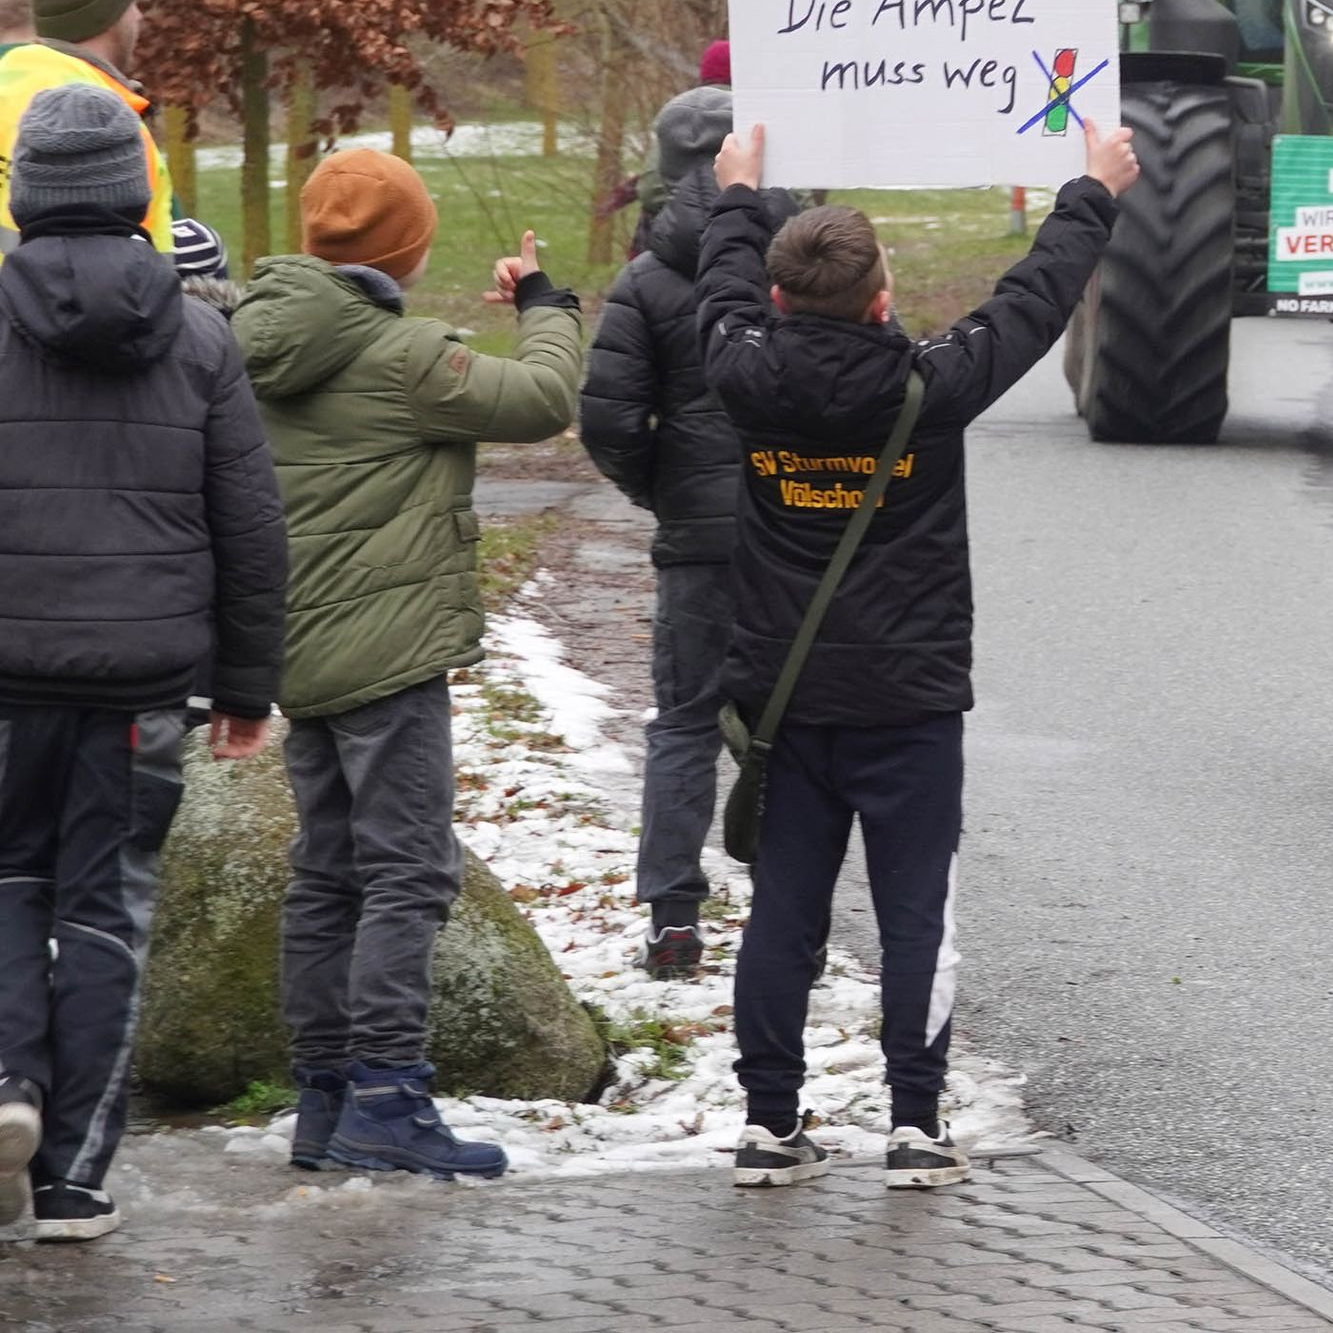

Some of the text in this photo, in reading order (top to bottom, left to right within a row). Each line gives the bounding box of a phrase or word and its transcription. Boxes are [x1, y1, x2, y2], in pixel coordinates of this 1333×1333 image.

[820, 58, 1018, 114] muss weg
[1277, 298, 1299, 312] NO
[752, 450, 916, 479] SV Sturmvoel
